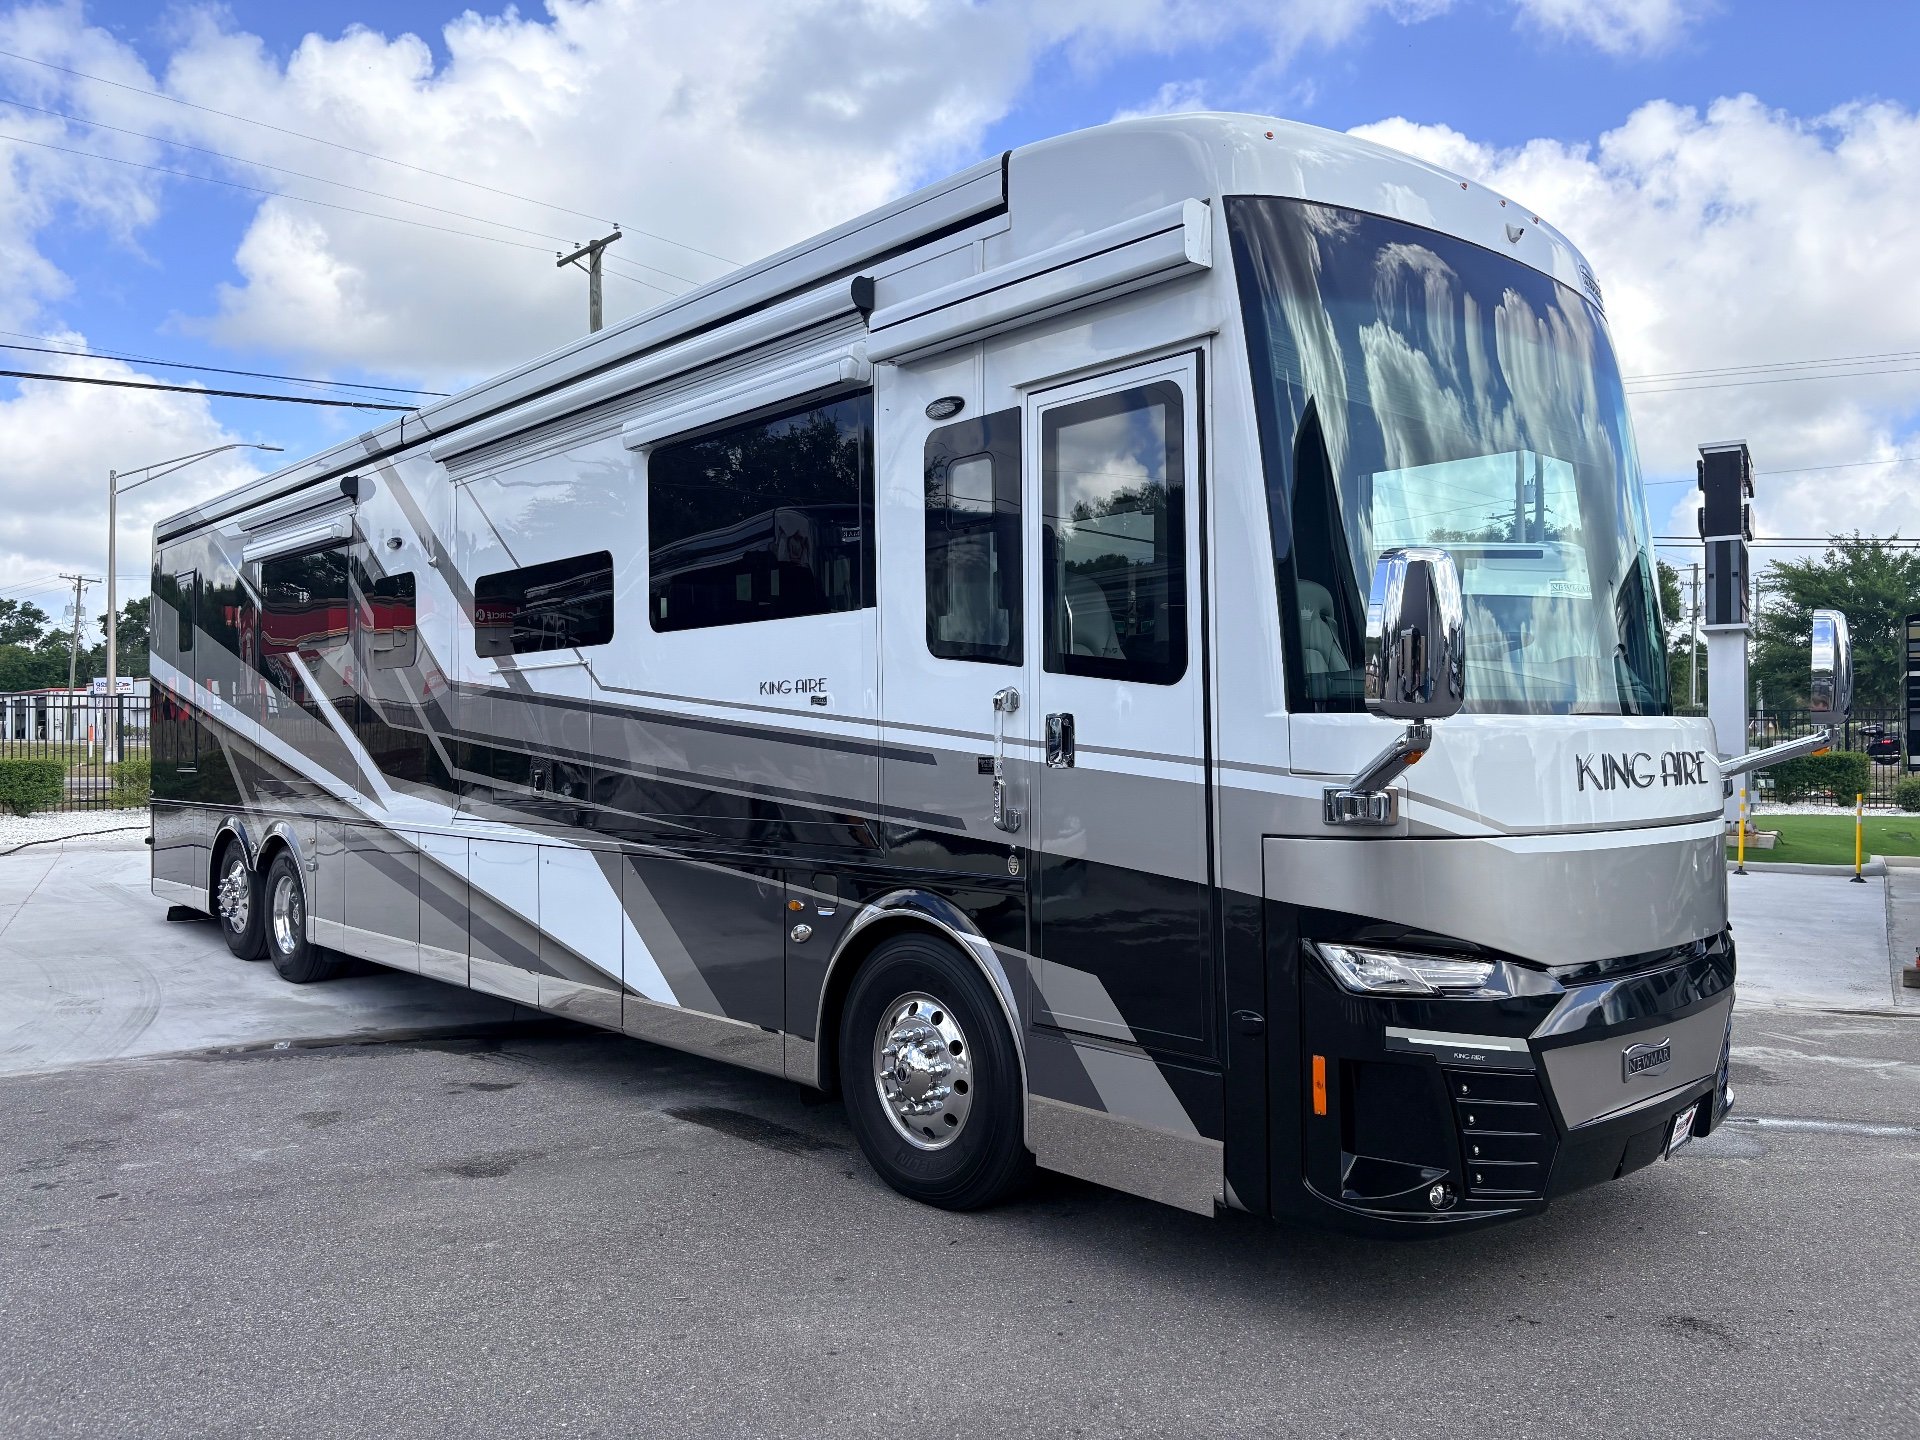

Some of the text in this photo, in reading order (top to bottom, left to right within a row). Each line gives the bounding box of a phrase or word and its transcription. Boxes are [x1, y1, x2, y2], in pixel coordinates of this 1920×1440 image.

[760, 678, 827, 695] KING AIRE
[1576, 751, 1708, 791] KING AIRE
[1453, 1052, 1470, 1060] KING
[1629, 1048, 1670, 1072] NEWMAR
